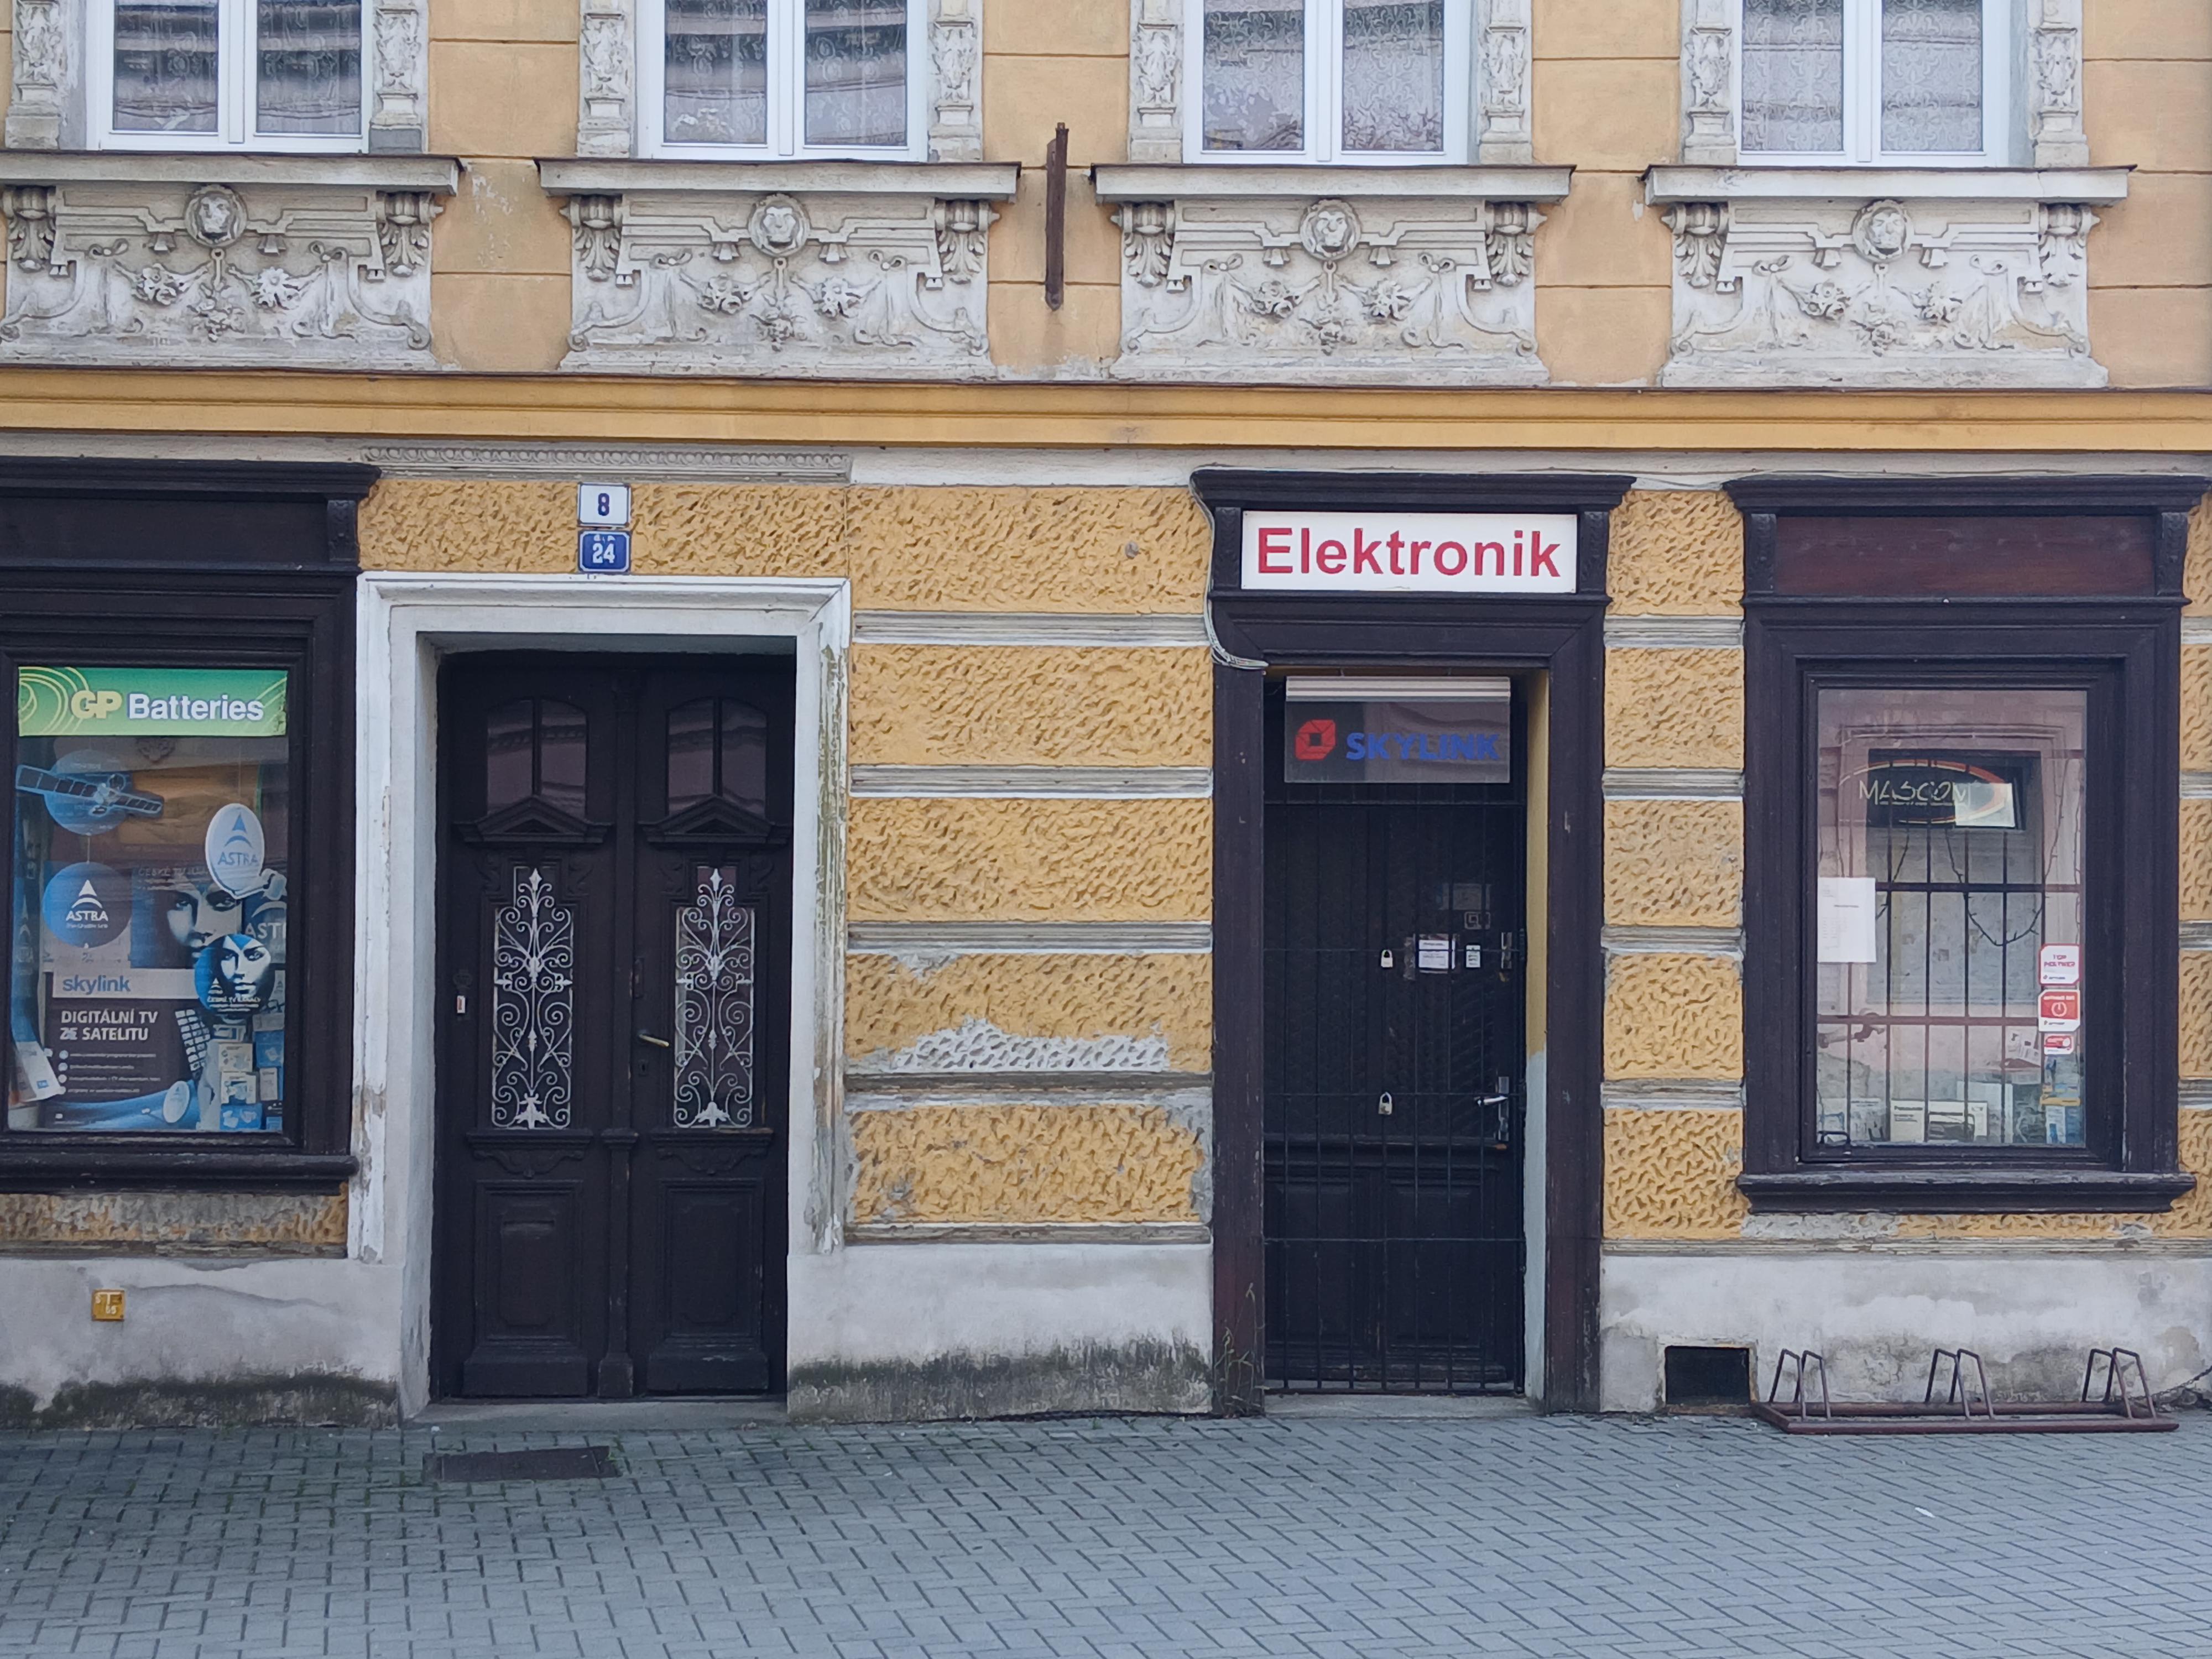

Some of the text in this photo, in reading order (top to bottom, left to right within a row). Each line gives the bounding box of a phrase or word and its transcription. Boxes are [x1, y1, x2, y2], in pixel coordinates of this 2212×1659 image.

[598, 493, 610, 516] 8
[592, 542, 615, 564] 24
[1258, 528, 1561, 577] Elektronik
[71, 690, 265, 721] GP Batteries
[1345, 732, 1500, 761] SKYLINK
[218, 852, 259, 866] ASTRA
[65, 910, 109, 922] ASTRA
[62, 974, 131, 995] skylink
[61, 1008, 158, 1024] DIGITÁLNÍ TV
[60, 1027, 149, 1041] ZE SATELITU
